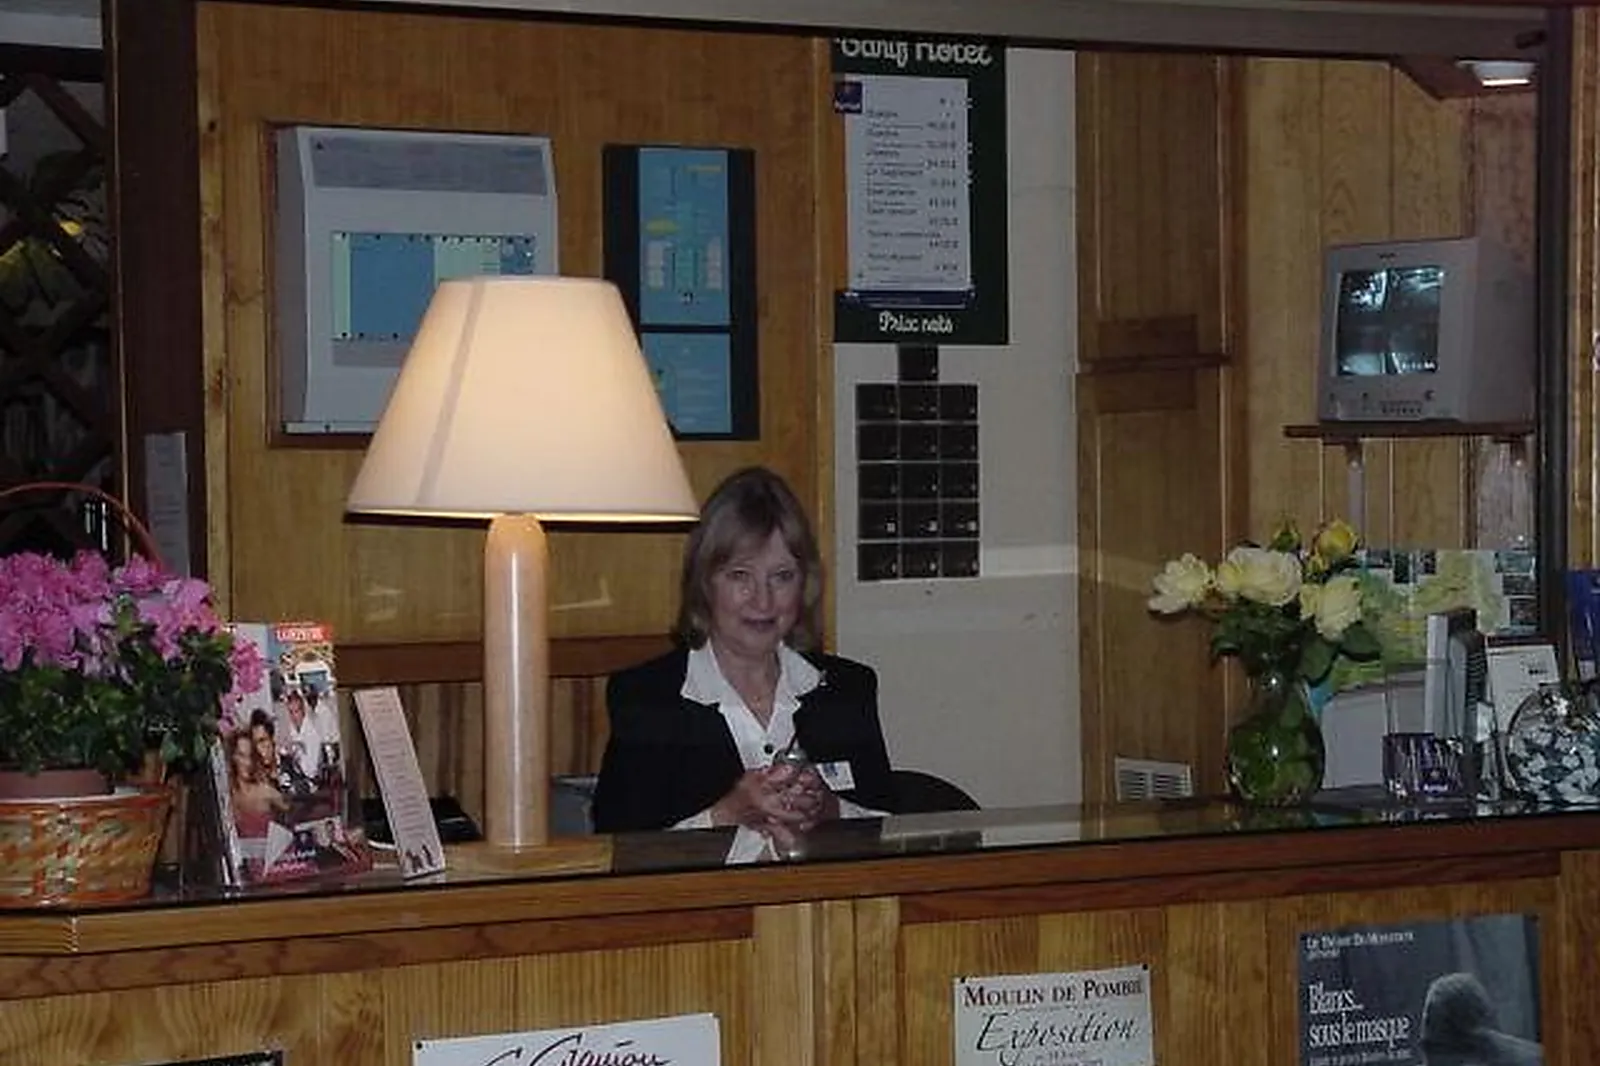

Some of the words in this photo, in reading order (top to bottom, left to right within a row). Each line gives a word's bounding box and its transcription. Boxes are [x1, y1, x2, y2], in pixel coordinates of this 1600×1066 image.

[963, 985, 1045, 1007] MOULIN
[1052, 985, 1077, 1003] DE
[976, 1011, 1139, 1051] Exposition
